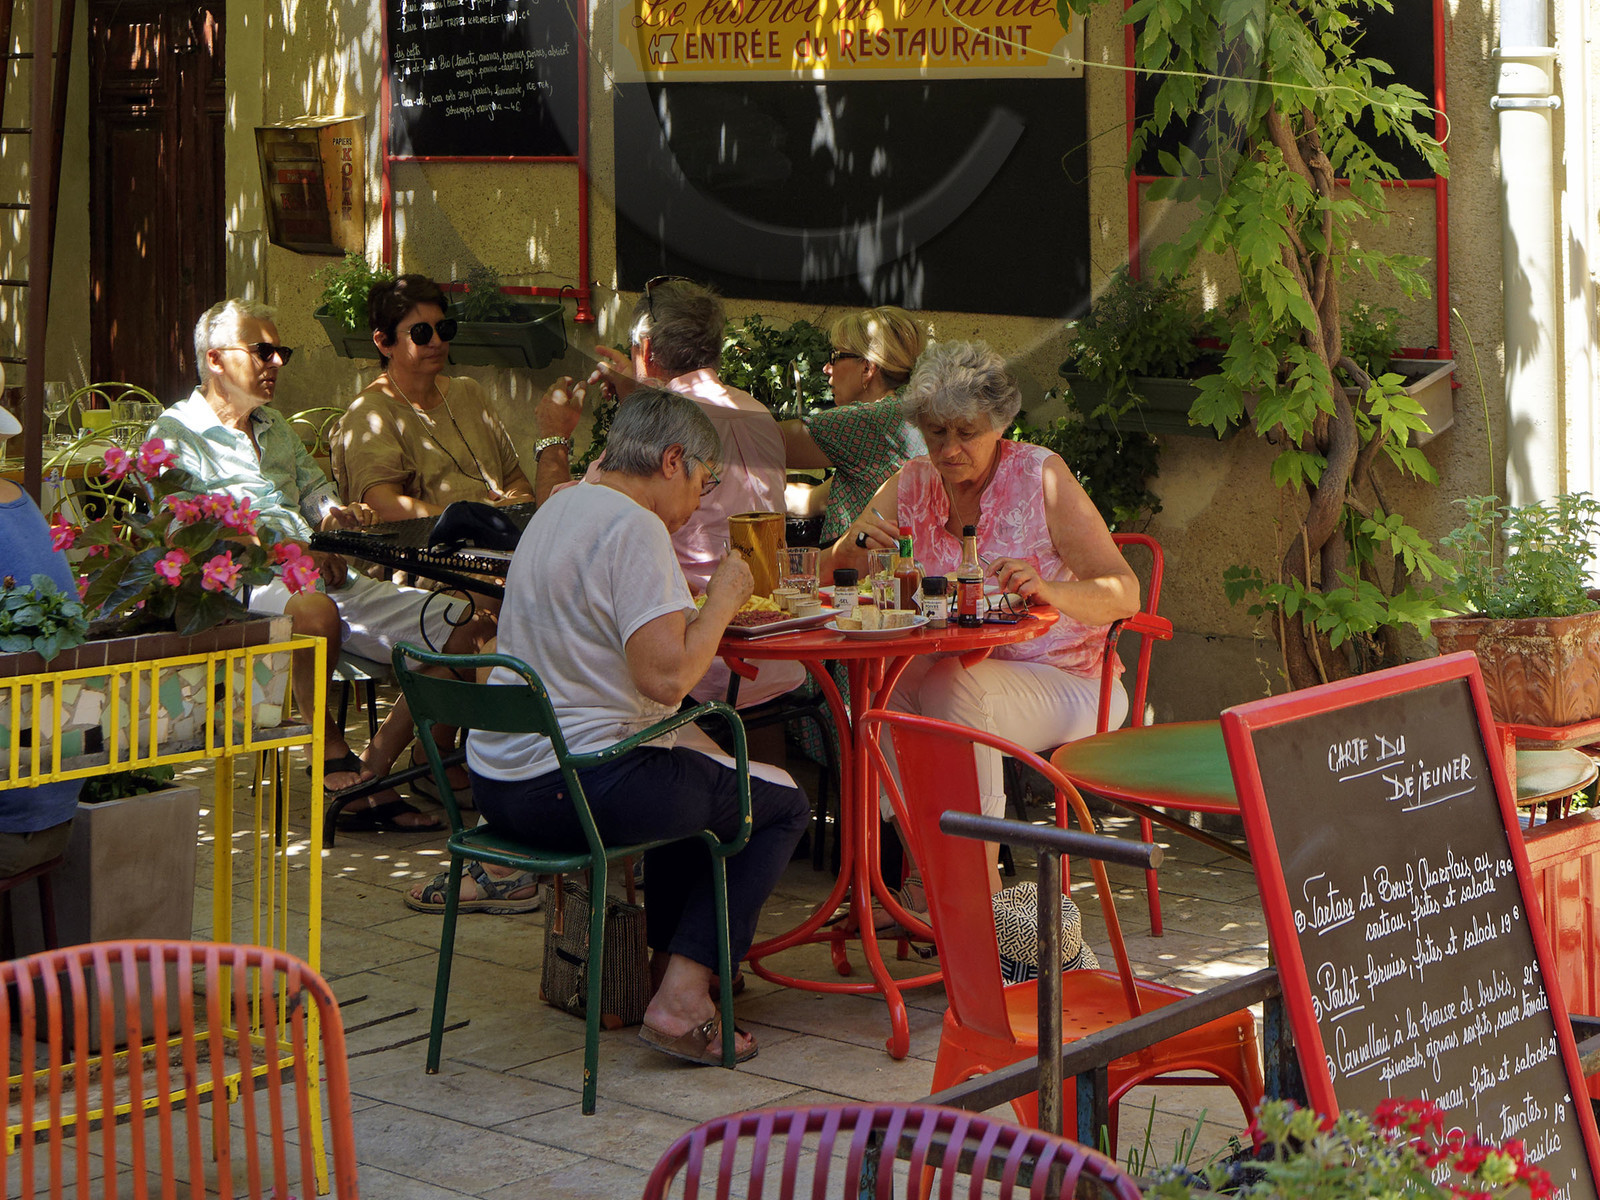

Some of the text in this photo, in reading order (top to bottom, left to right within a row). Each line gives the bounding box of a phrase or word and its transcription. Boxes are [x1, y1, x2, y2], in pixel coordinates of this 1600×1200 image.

[684, 24, 1033, 64] ENTRÉE du RESTAURANT
[332, 137, 353, 146] PAPIERS
[341, 147, 353, 221] KODAK
[1328, 733, 1406, 773] CARTE DU
[1303, 871, 1356, 929] Tartare
[1359, 875, 1376, 912] de
[1473, 851, 1493, 873] au
[1365, 870, 1497, 941] couteau, frites et salade
[1316, 961, 1361, 1013] Poulet
[1412, 933, 1443, 984] frites
[1444, 926, 1458, 955] et
[1462, 911, 1498, 951] salade
[1393, 1014, 1404, 1048] à
[1406, 1004, 1421, 1041] la
[1419, 1000, 1456, 1033] brousse
[1459, 985, 1474, 1016] de
[1477, 969, 1517, 1009] brebis,
[1425, 1030, 1459, 1084] oignons
[1496, 1005, 1520, 1031] sauce
[1521, 985, 1549, 1021] tomate
[1470, 1062, 1497, 1118] frites
[1498, 1053, 1511, 1081] et
[1514, 1037, 1548, 1075] salade
